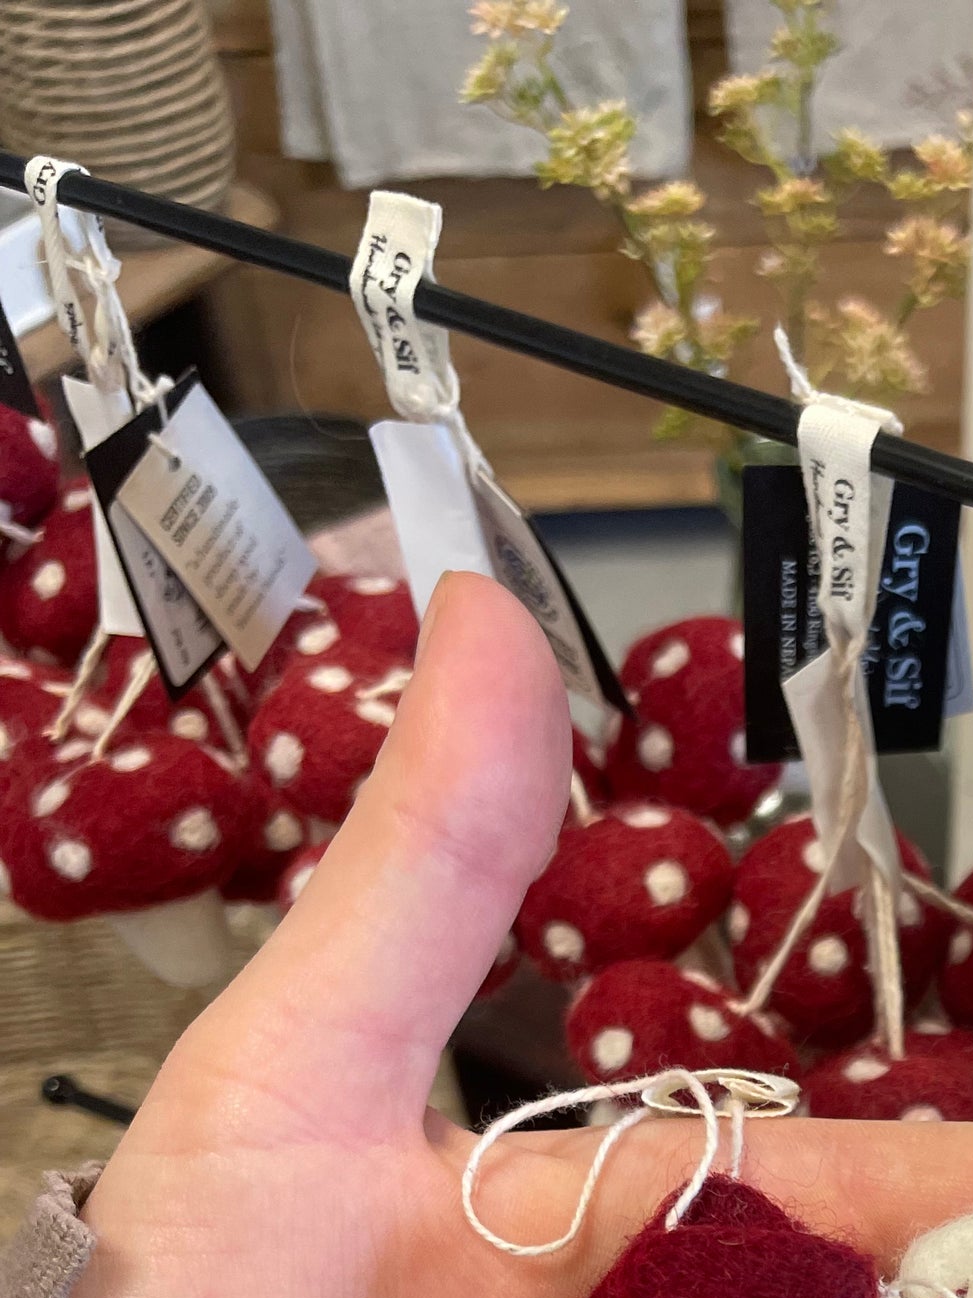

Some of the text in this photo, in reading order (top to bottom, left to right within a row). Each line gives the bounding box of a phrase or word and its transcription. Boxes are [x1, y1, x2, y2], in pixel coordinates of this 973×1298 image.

[379, 252, 421, 375] Gry & Sif
[781, 560, 798, 608] MADE
[827, 478, 856, 602] Gry & Sif
[781, 613, 798, 631] IN
[881, 523, 931, 710] Gry & Sif
